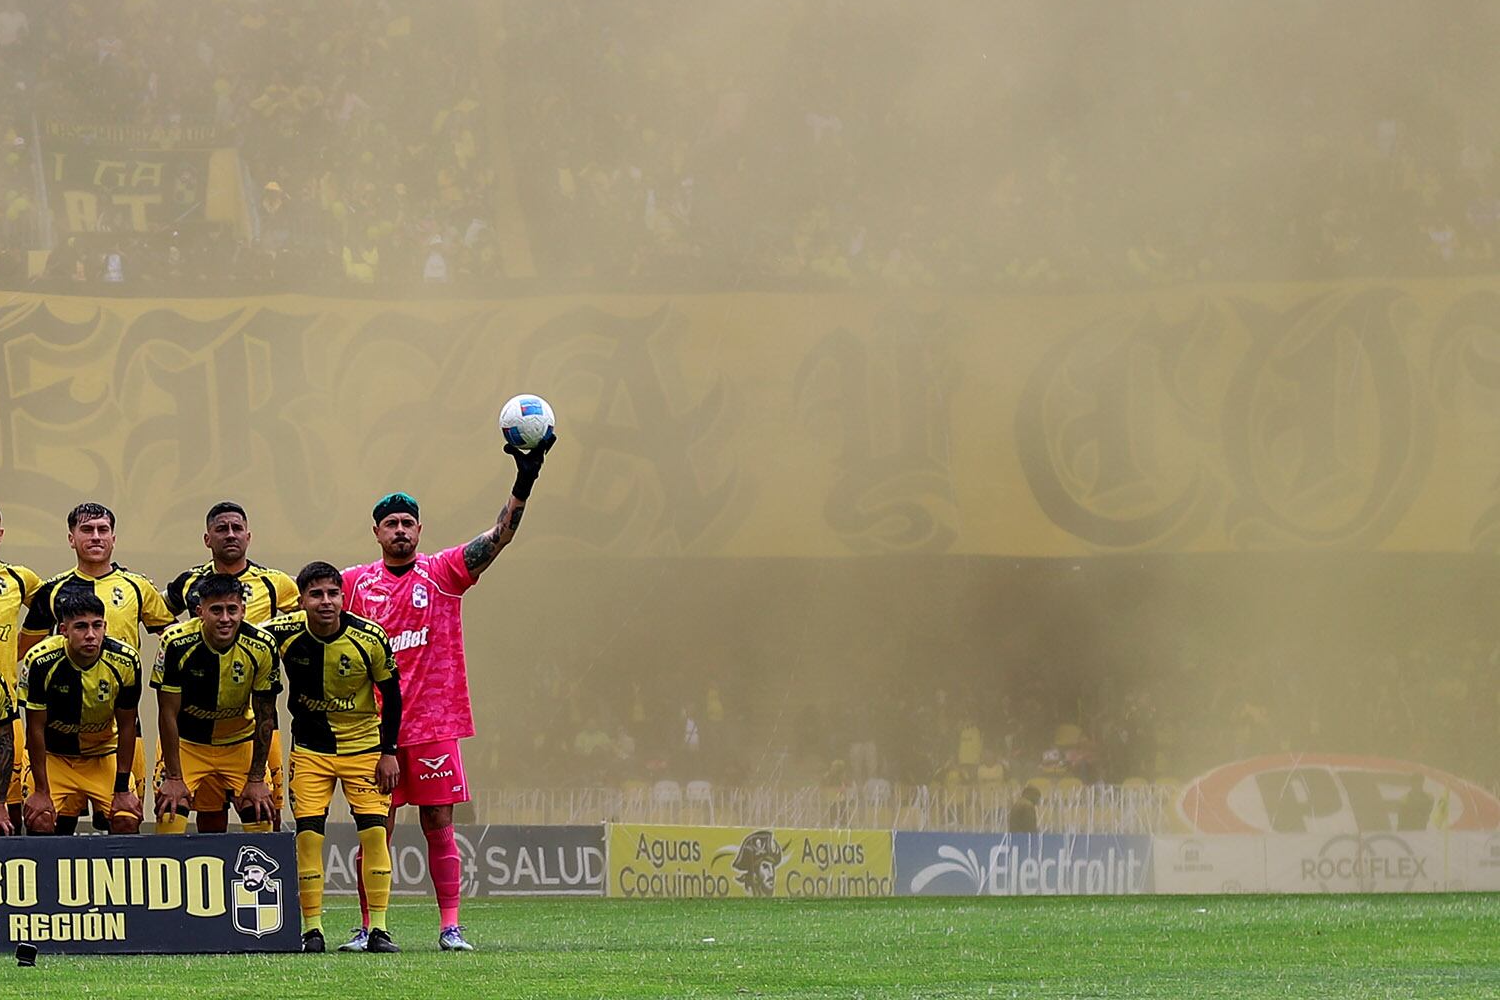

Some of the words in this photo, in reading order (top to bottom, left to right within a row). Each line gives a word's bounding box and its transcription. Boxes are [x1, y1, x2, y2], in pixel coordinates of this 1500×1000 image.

[389, 626, 429, 654] aBet
[485, 846, 606, 886] SALUD
[635, 832, 701, 868] Aguas
[801, 837, 864, 870] Aguas
[57, 855, 227, 918] UNIDO
[619, 866, 729, 897] Coquimbo
[989, 844, 1141, 895] Electrolit
[8, 907, 127, 942] REGIÓN
